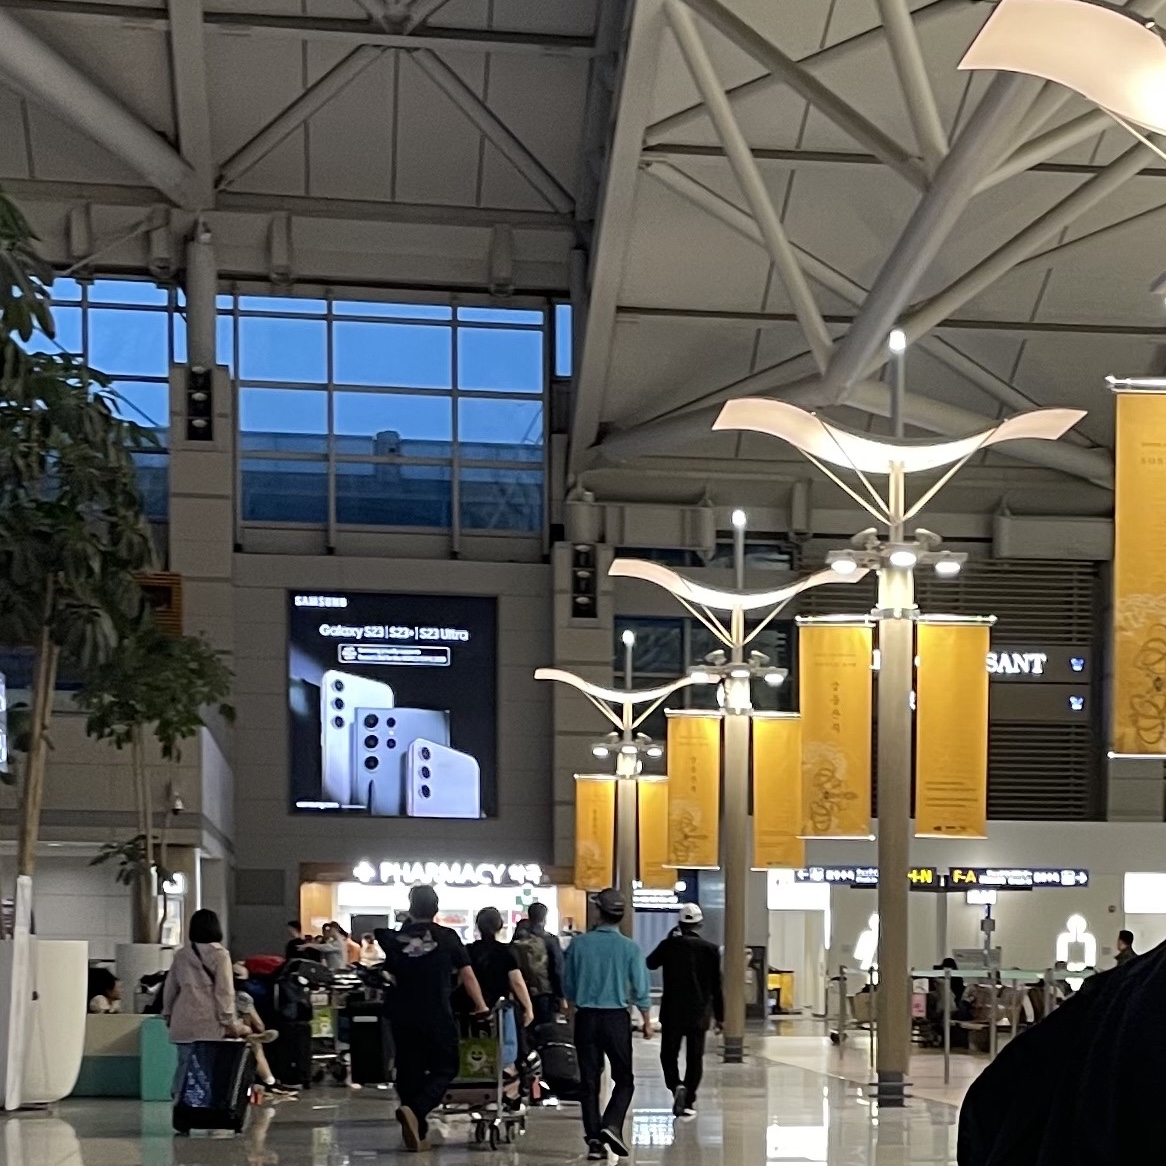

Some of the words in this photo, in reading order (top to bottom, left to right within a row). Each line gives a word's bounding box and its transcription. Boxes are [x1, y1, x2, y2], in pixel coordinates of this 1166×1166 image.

[294, 595, 348, 608] SAMSUNG
[319, 623, 363, 640] Galaxy
[363, 625, 385, 638] S23
[419, 627, 439, 640] S23
[440, 628, 469, 641] Ultra
[380, 861, 506, 884] PHARMACY
